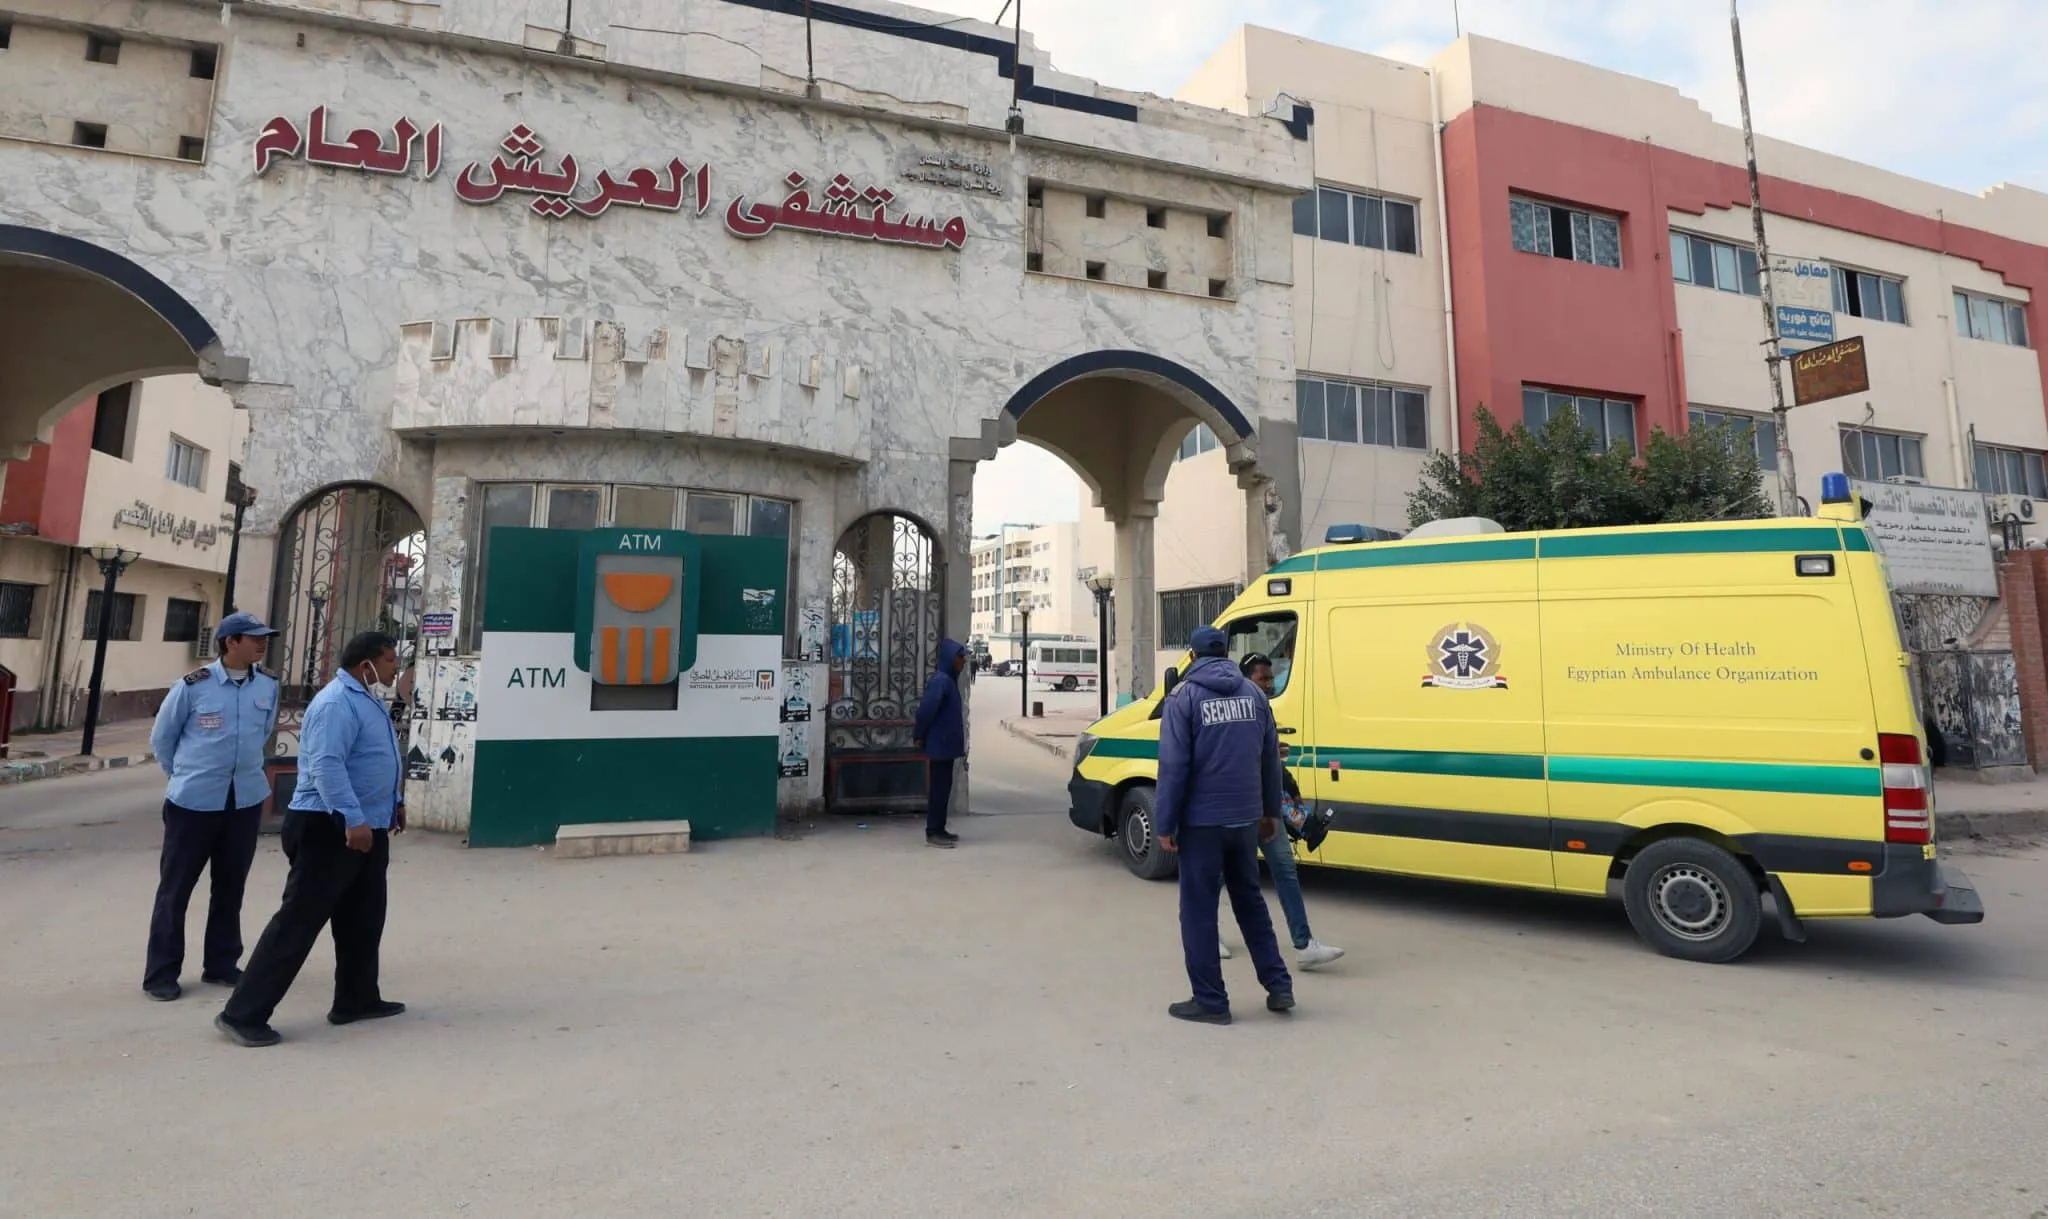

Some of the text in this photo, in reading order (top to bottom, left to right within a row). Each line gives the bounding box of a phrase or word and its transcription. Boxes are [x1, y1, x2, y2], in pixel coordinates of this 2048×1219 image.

[253, 104, 969, 252] مستشفى العريش العام
[618, 534, 661, 550] ATM
[1615, 641, 1757, 659] Ministry Of Health
[507, 667, 566, 689] ATM
[1567, 666, 1819, 684] Egyptian Ambulance Organization
[1203, 699, 1253, 723] SECURITY
